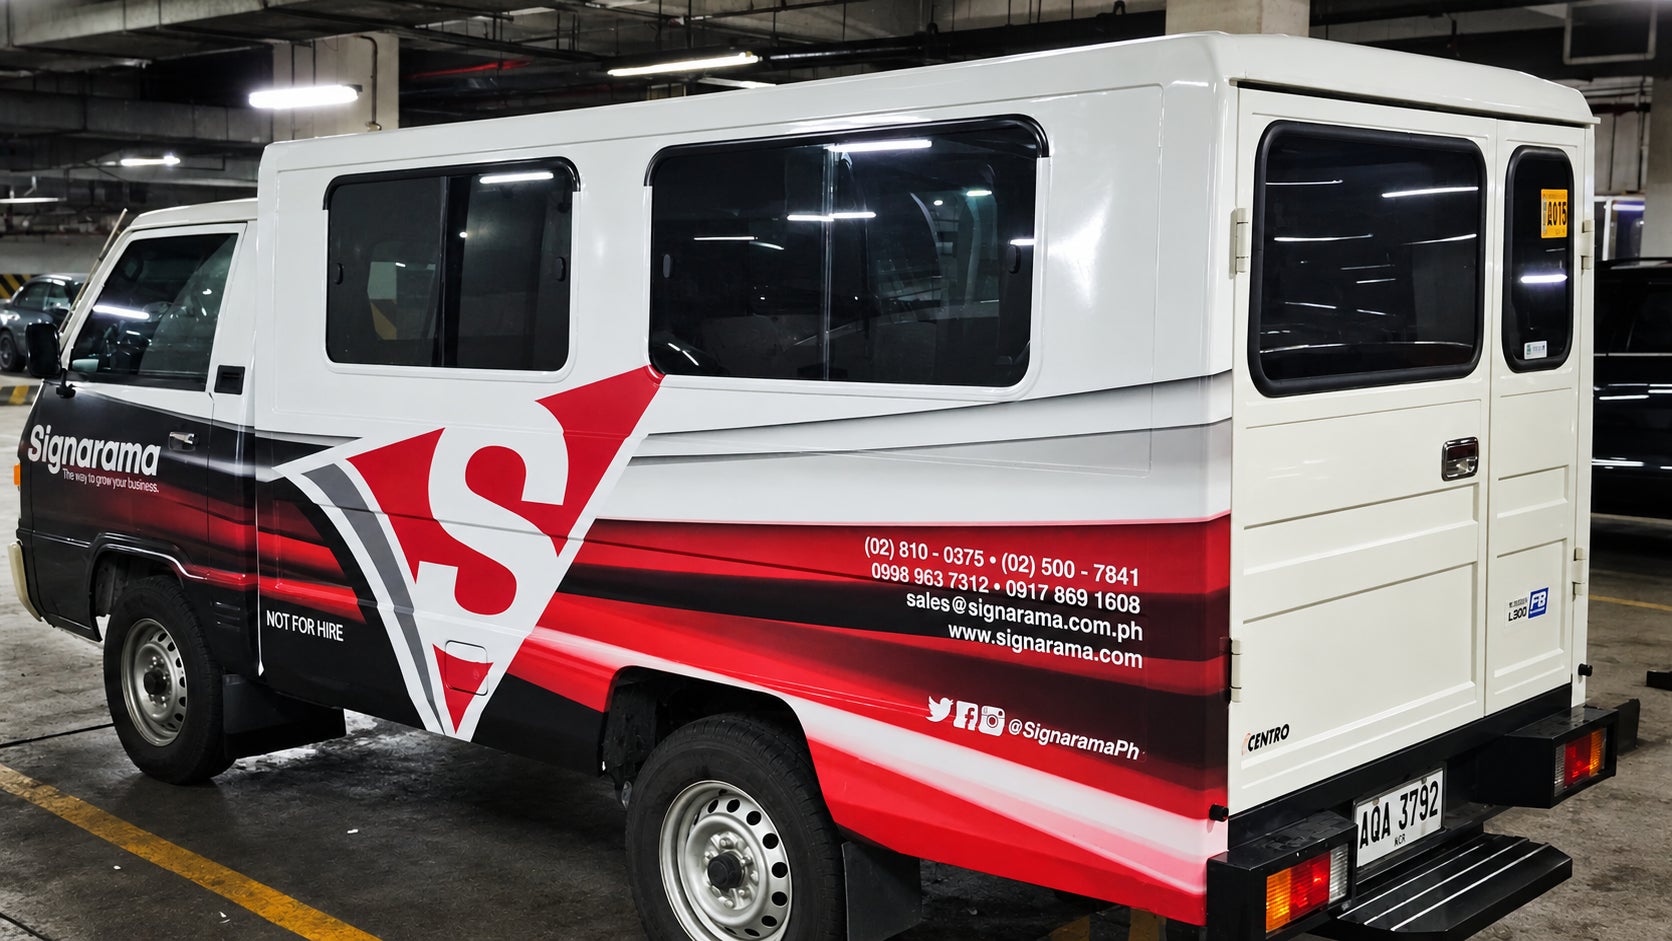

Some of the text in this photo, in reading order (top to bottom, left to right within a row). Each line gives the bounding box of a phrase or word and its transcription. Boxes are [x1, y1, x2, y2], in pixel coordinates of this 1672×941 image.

[28, 424, 161, 476] Signarama
[62, 467, 75, 481] The
[75, 472, 88, 485] way
[88, 473, 95, 484] to
[95, 475, 112, 487] grow
[111, 478, 127, 489] your
[865, 536, 894, 560] (02)
[899, 541, 928, 560] 810
[943, 546, 984, 567] 0375
[1001, 553, 1036, 578] (02)
[1041, 557, 1075, 579] 500
[1093, 563, 1138, 587] 7841
[871, 562, 909, 583] 0998
[914, 568, 943, 587] 963
[948, 571, 989, 593] 7312
[1005, 579, 1049, 601] 0917
[1054, 586, 1088, 607] 869
[1094, 590, 1141, 614] 1608
[266, 610, 344, 642] NOT FOR HIRE
[906, 591, 1143, 642] sales@signarama.com.ph
[1508, 606, 1528, 622] L300
[948, 624, 1143, 669] www.signarama.com
[1008, 718, 1140, 760] @SignaramaPh
[1247, 723, 1290, 752] CENTRO
[1360, 780, 1439, 850] AQA 3792
